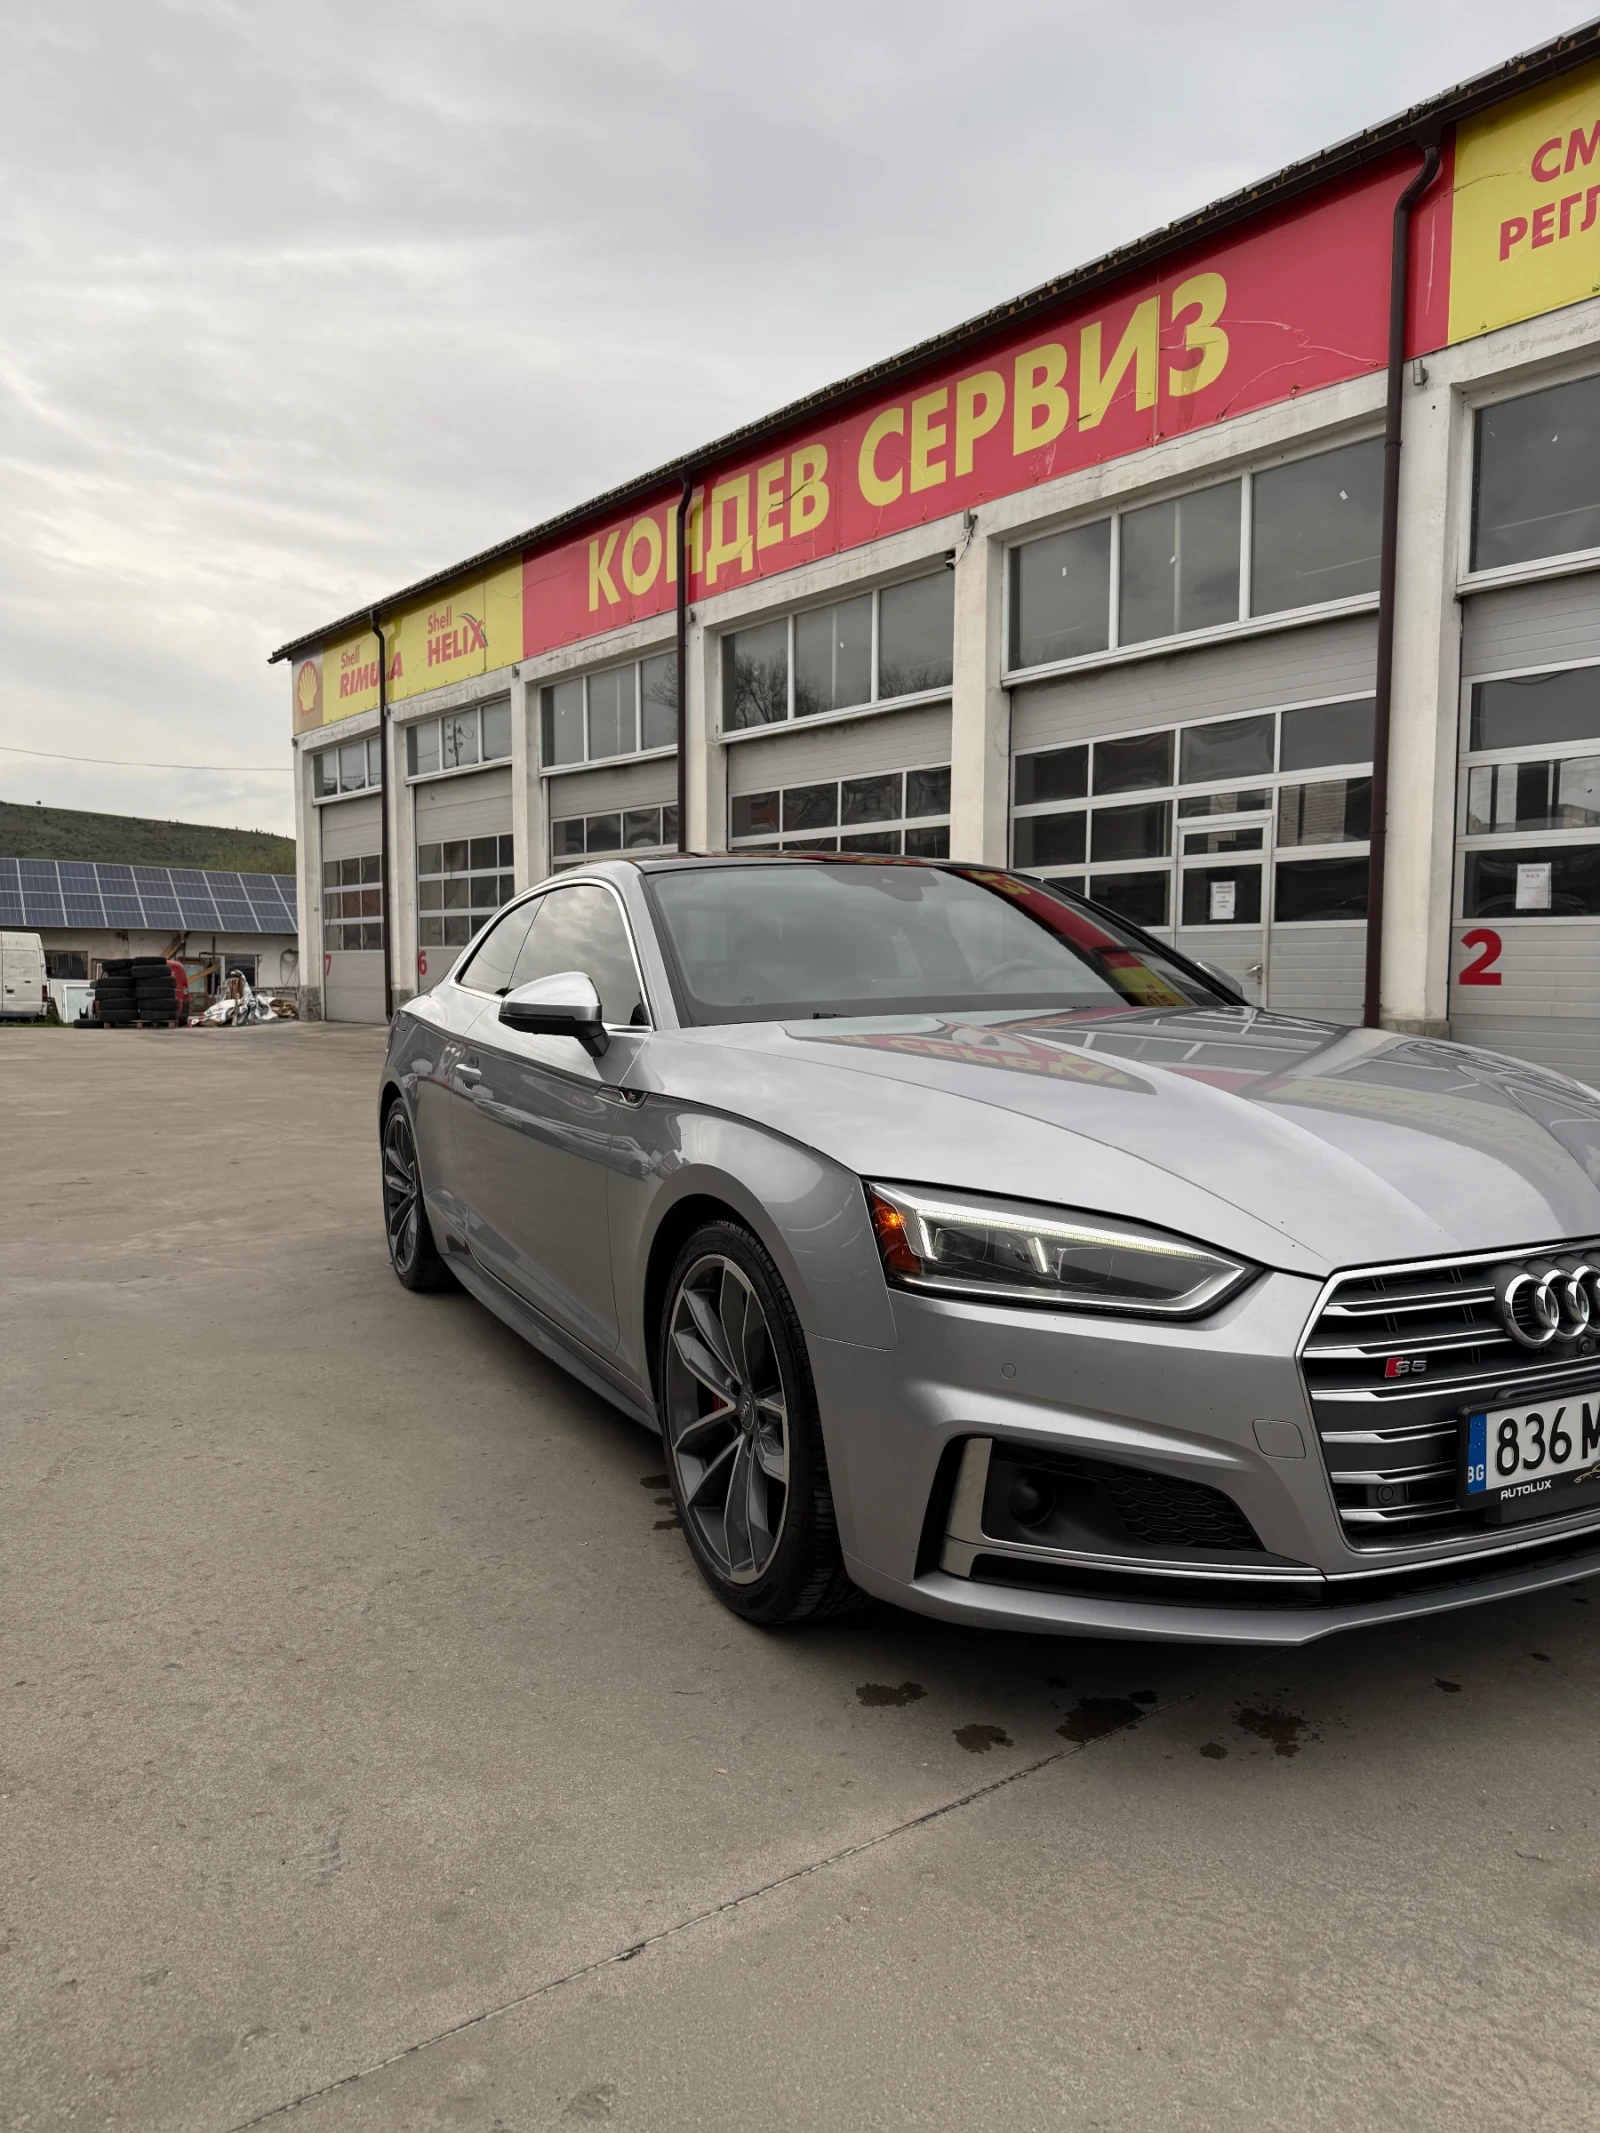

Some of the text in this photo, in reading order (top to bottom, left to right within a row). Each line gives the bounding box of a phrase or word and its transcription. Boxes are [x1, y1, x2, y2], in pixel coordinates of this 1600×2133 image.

[588, 272, 1230, 612] КОНДЕВ СЕРВИЗ
[427, 605, 453, 635] Shell
[427, 613, 486, 667] HELIX
[341, 645, 360, 669] Shell
[340, 651, 403, 699] RIMUA
[325, 954, 332, 976] 7
[417, 950, 427, 975] 6
[1459, 928, 1502, 985] 2
[1395, 1360, 1427, 1374] S5
[1467, 1464, 1485, 1483] BG
[1500, 1480, 1552, 1500] AUTOLUX
